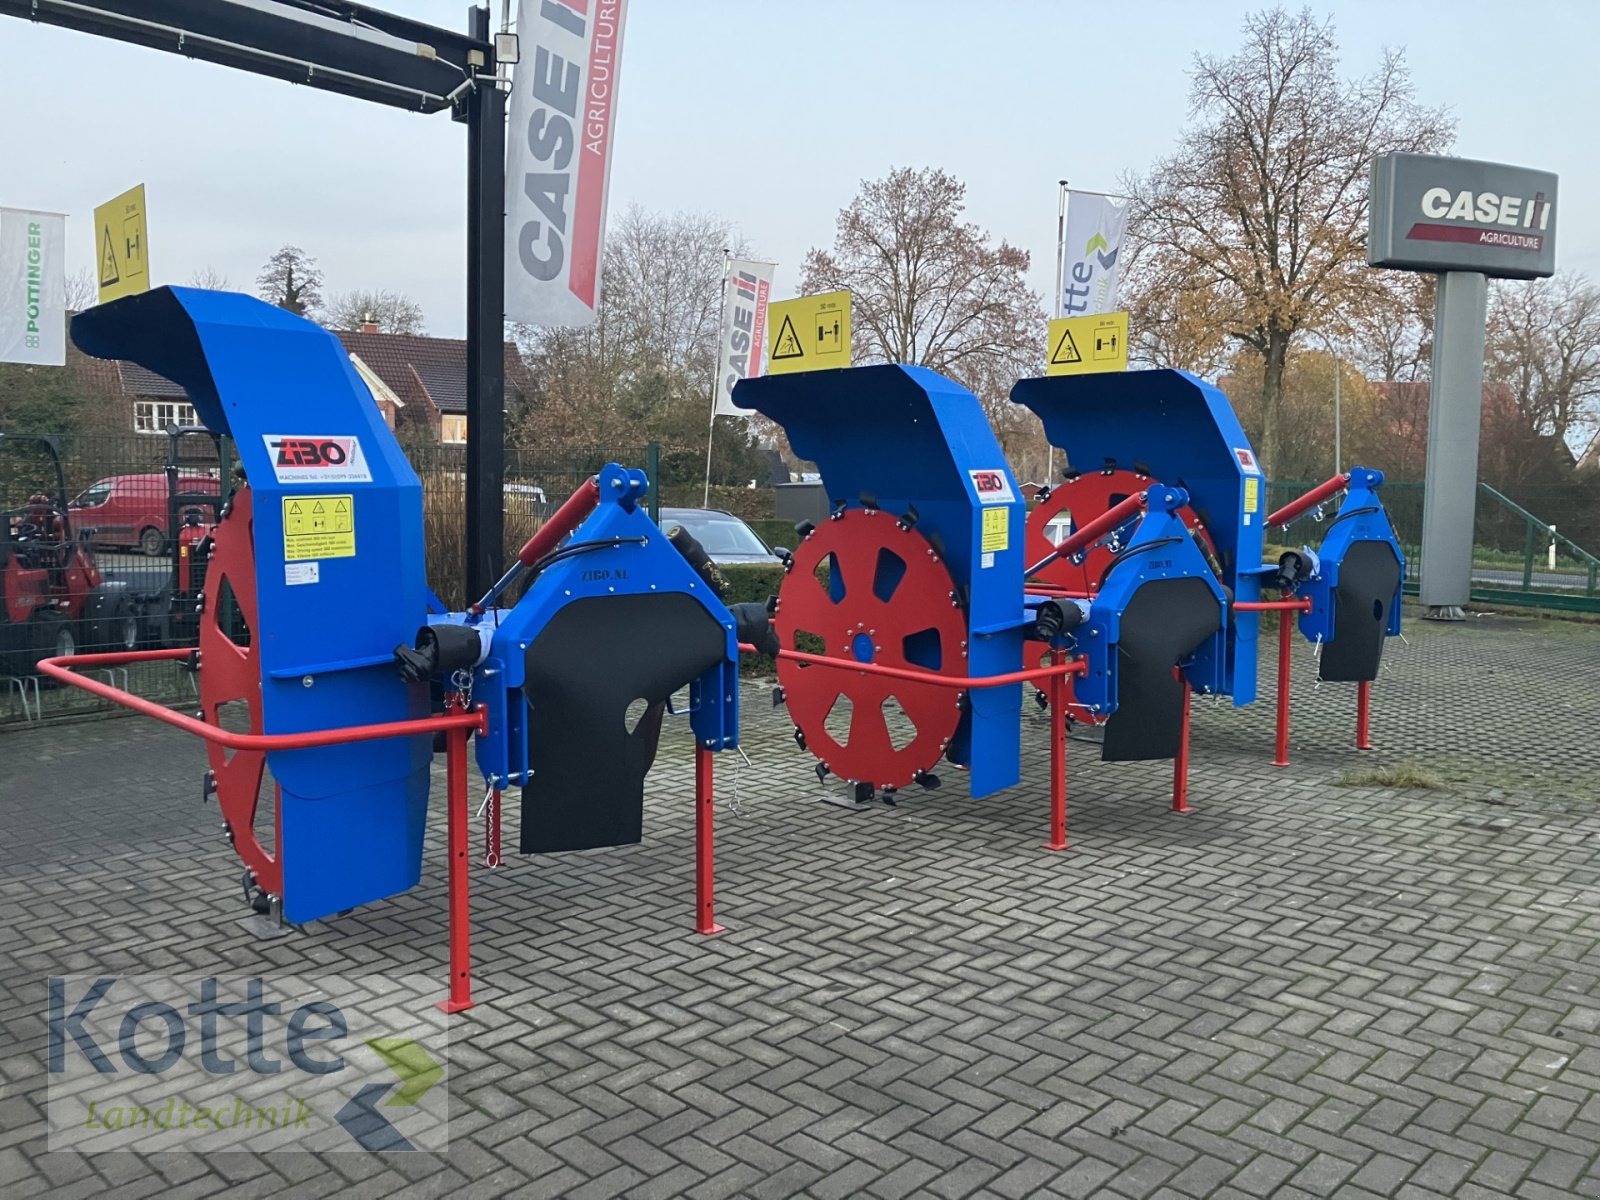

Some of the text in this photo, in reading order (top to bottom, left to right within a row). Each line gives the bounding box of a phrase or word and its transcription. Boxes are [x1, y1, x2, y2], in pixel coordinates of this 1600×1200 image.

[518, 45, 581, 282] CASE
[1421, 187, 1522, 226] CASE
[1480, 231, 1539, 249] AGRICULTURE
[754, 282, 769, 348] AGRICULTURE
[1064, 262, 1093, 317] tte
